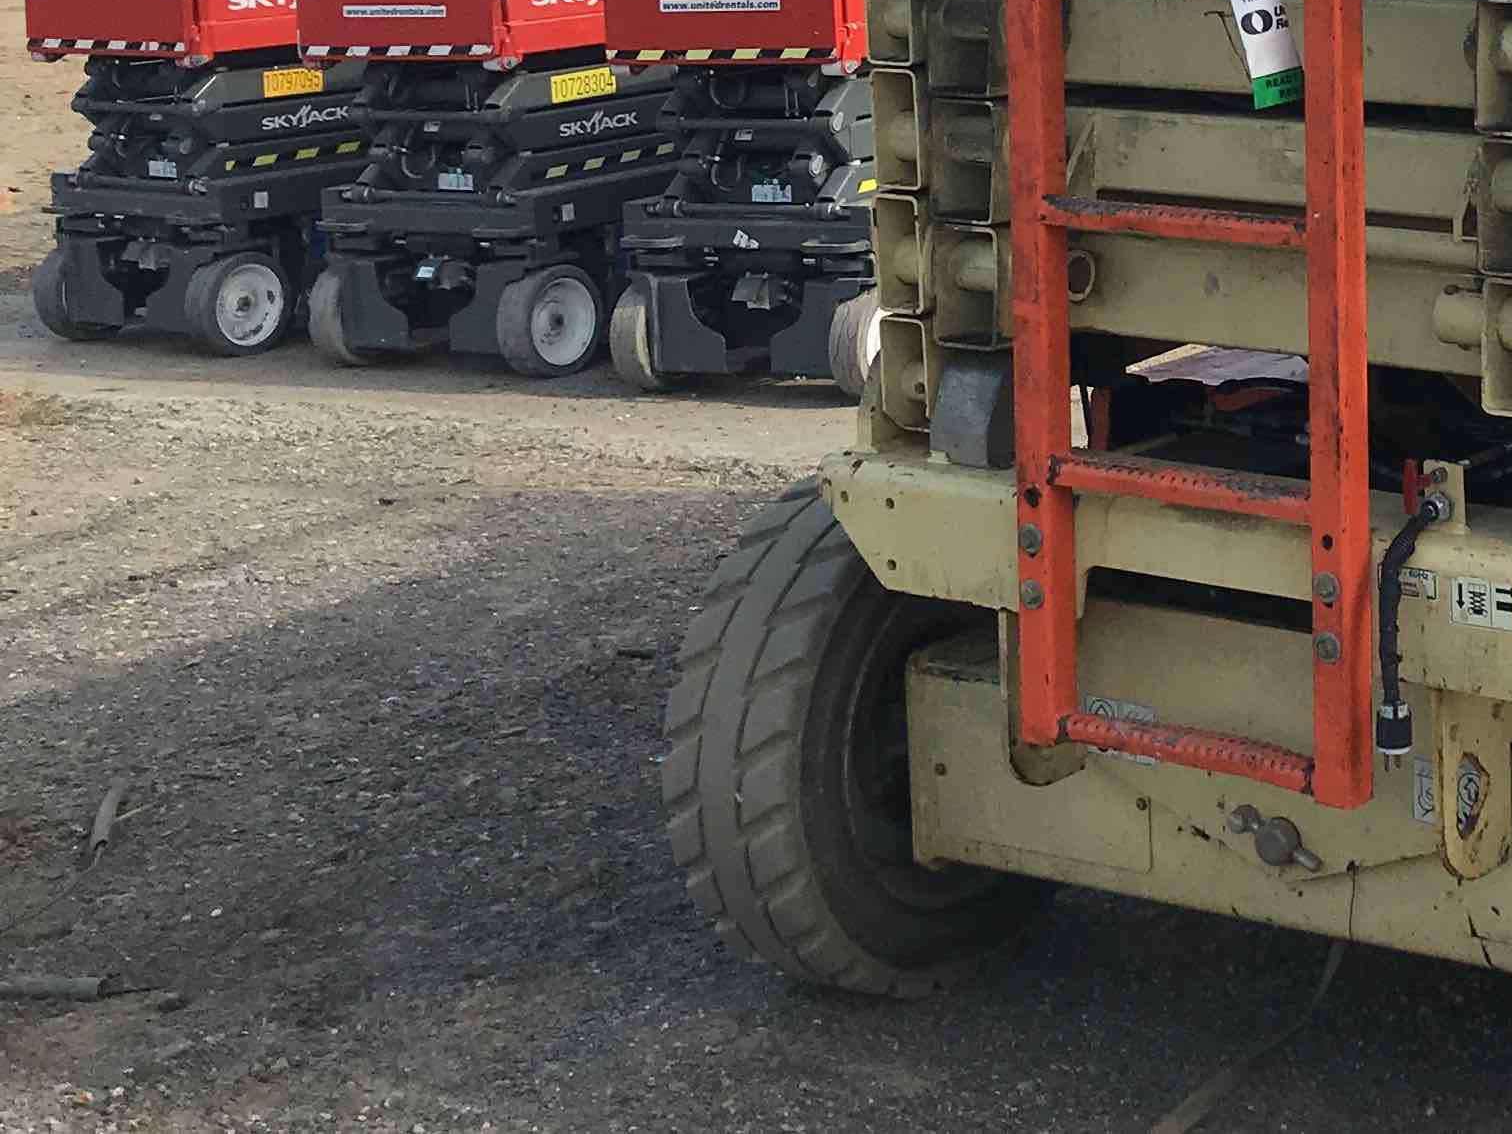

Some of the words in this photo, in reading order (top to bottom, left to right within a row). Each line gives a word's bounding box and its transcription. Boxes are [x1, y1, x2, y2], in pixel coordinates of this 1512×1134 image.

[662, 0, 779, 11] www.unitedrentals.com
[553, 72, 614, 100] 10728304
[261, 104, 350, 131] SKYJACK
[559, 110, 639, 137] SKYJACK
